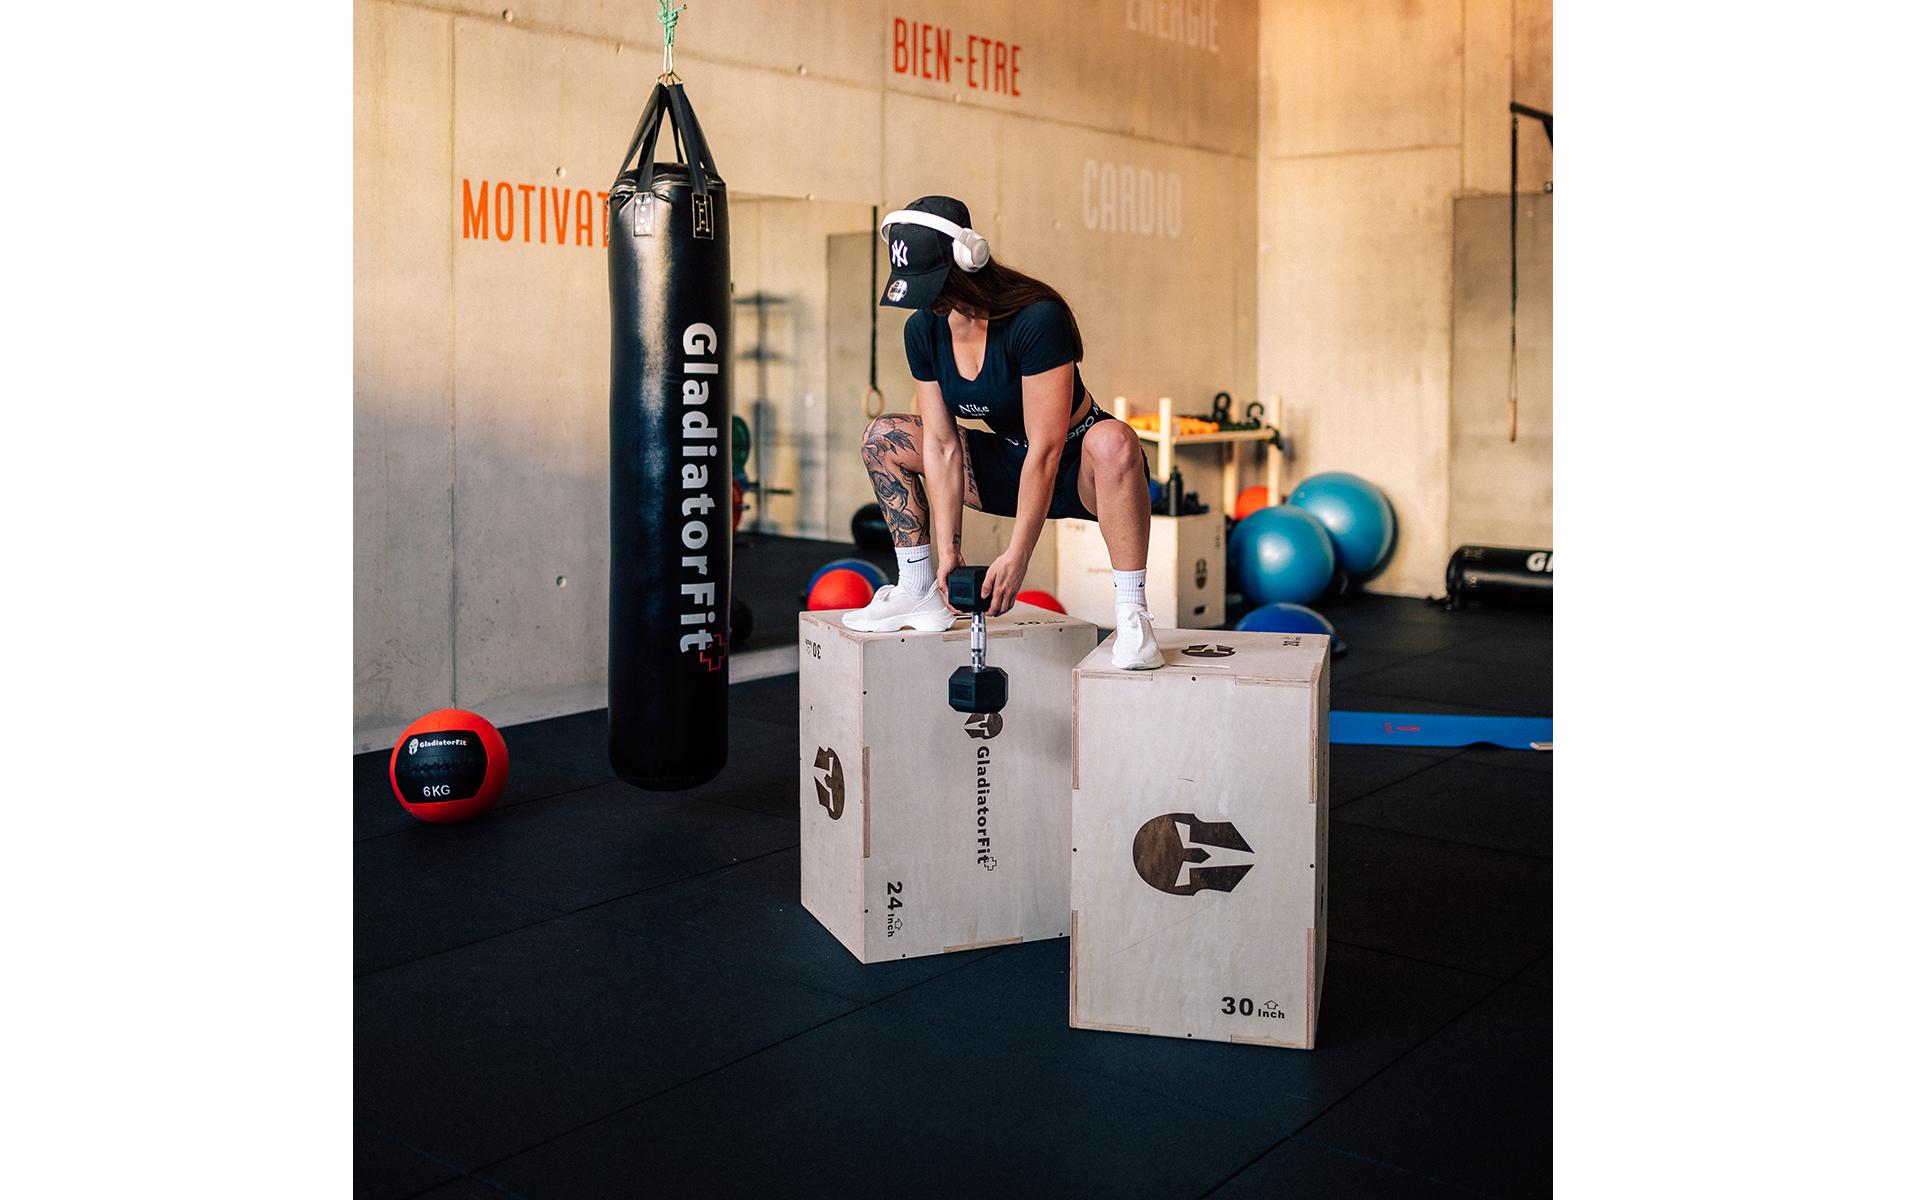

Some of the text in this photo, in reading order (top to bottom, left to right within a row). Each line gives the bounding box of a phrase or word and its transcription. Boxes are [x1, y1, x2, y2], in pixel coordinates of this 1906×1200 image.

[894, 17, 1022, 97] BIEN-ETRE
[463, 179, 608, 248] MOTIVAT
[1083, 159, 1182, 240] CARDIO
[958, 404, 990, 415] Nike
[680, 322, 718, 653] GladiatorFit
[812, 642, 821, 660] 30
[419, 739, 467, 749] GladiatorFit
[977, 746, 991, 864] GladiatorFit
[887, 881, 903, 937] 24 Inch
[1221, 996, 1285, 1019] 30 Inch
